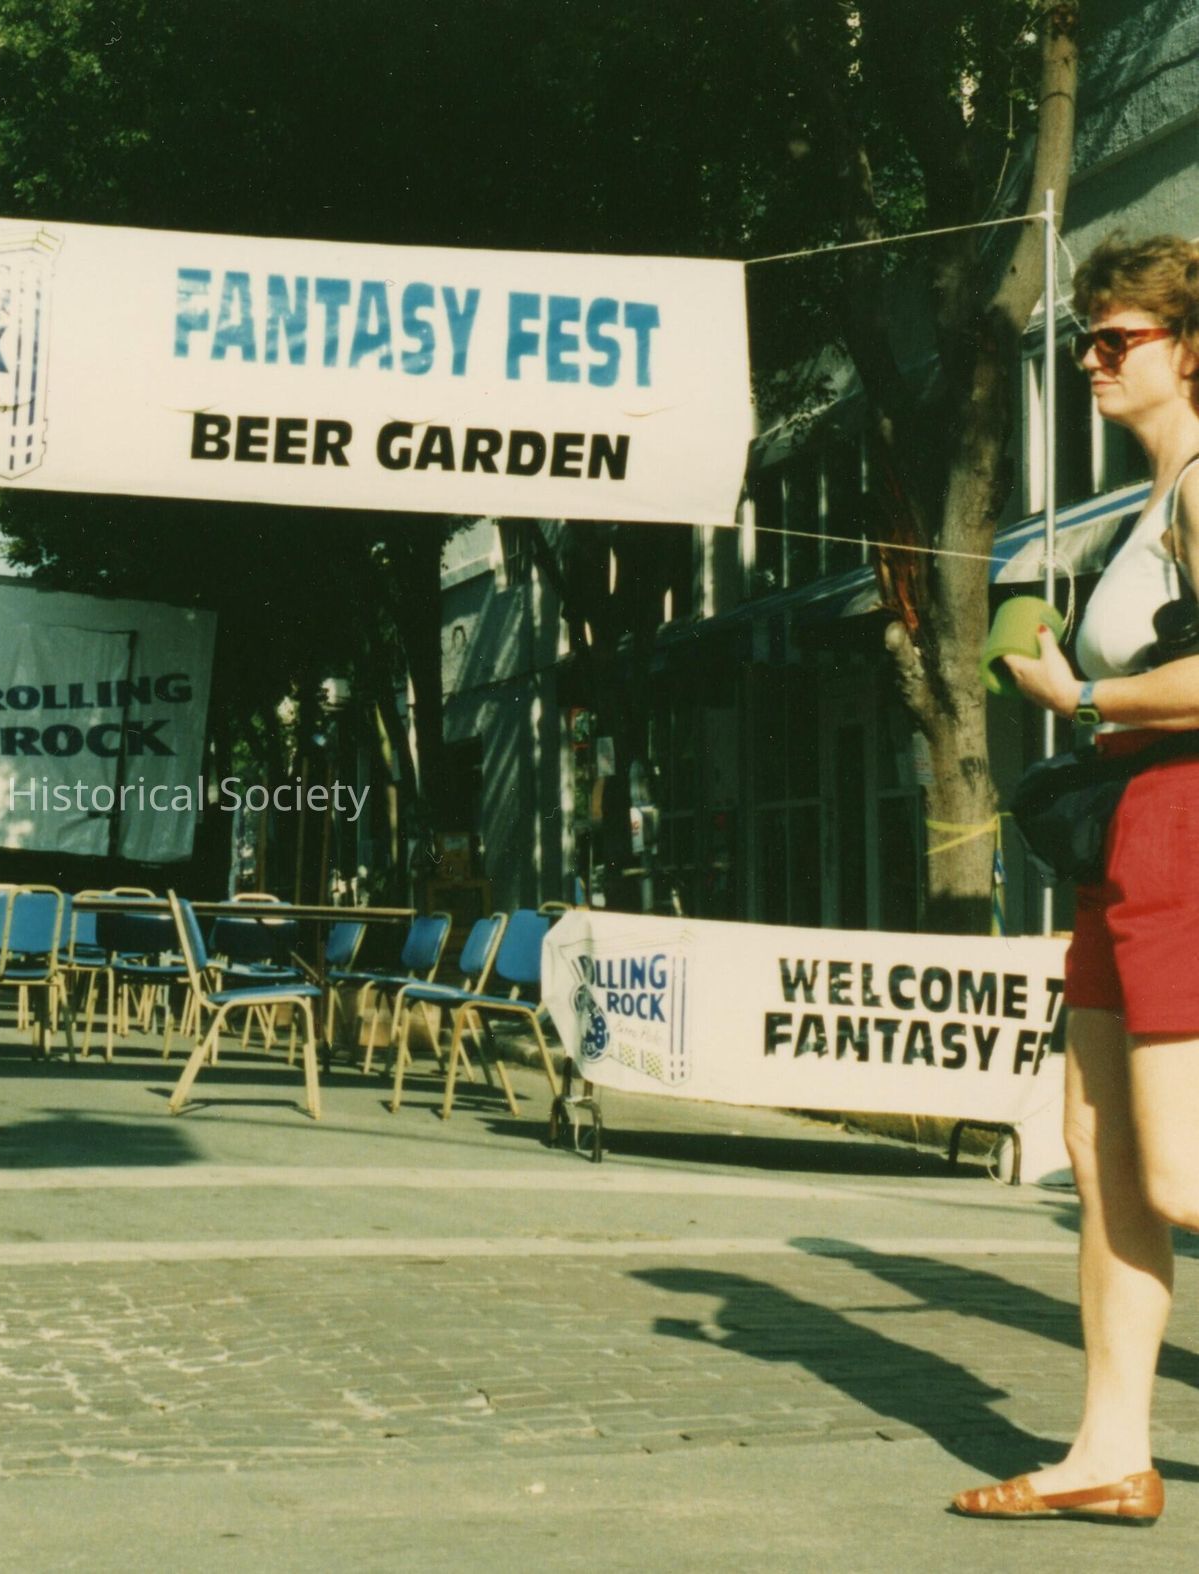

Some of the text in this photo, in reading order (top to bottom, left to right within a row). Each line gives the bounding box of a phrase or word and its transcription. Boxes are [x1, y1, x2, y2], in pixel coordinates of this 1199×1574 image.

[174, 267, 661, 388] FANTASY FEST
[190, 411, 631, 480] BEER GARDEN
[0, 719, 176, 758] ROCK
[605, 991, 667, 1023] ROCK
[778, 958, 1066, 1023] WELCOME T
[764, 1011, 1000, 1072] FANTASY
